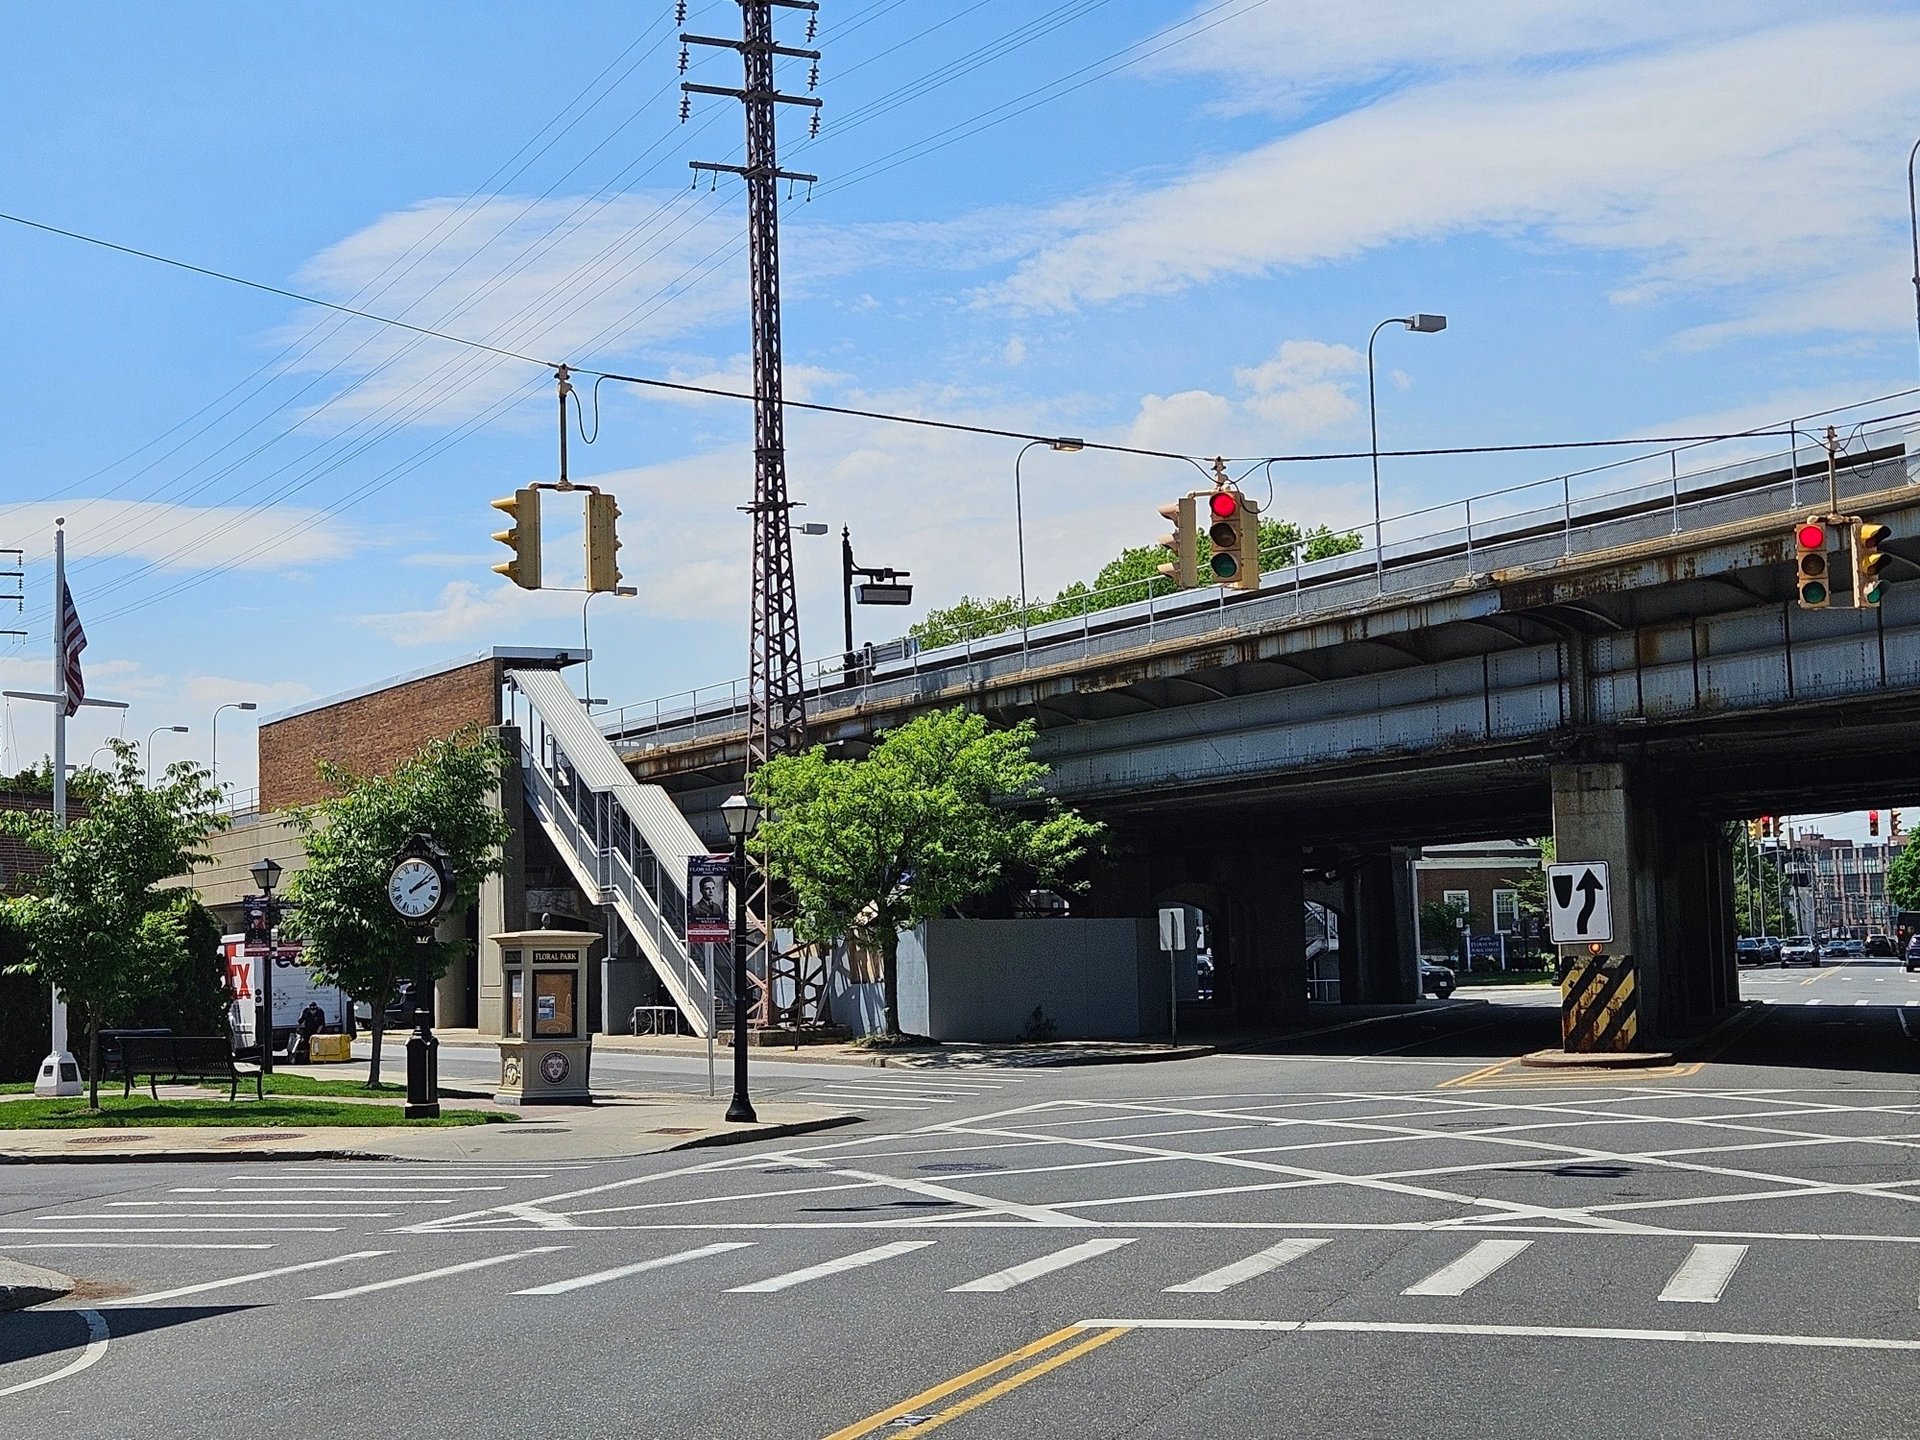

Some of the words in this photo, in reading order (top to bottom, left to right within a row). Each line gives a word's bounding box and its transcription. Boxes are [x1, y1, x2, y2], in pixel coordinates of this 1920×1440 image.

[398, 850, 420, 861] FLORAL
[535, 952, 559, 960] FLORAL
[560, 952, 577, 960] PARK
